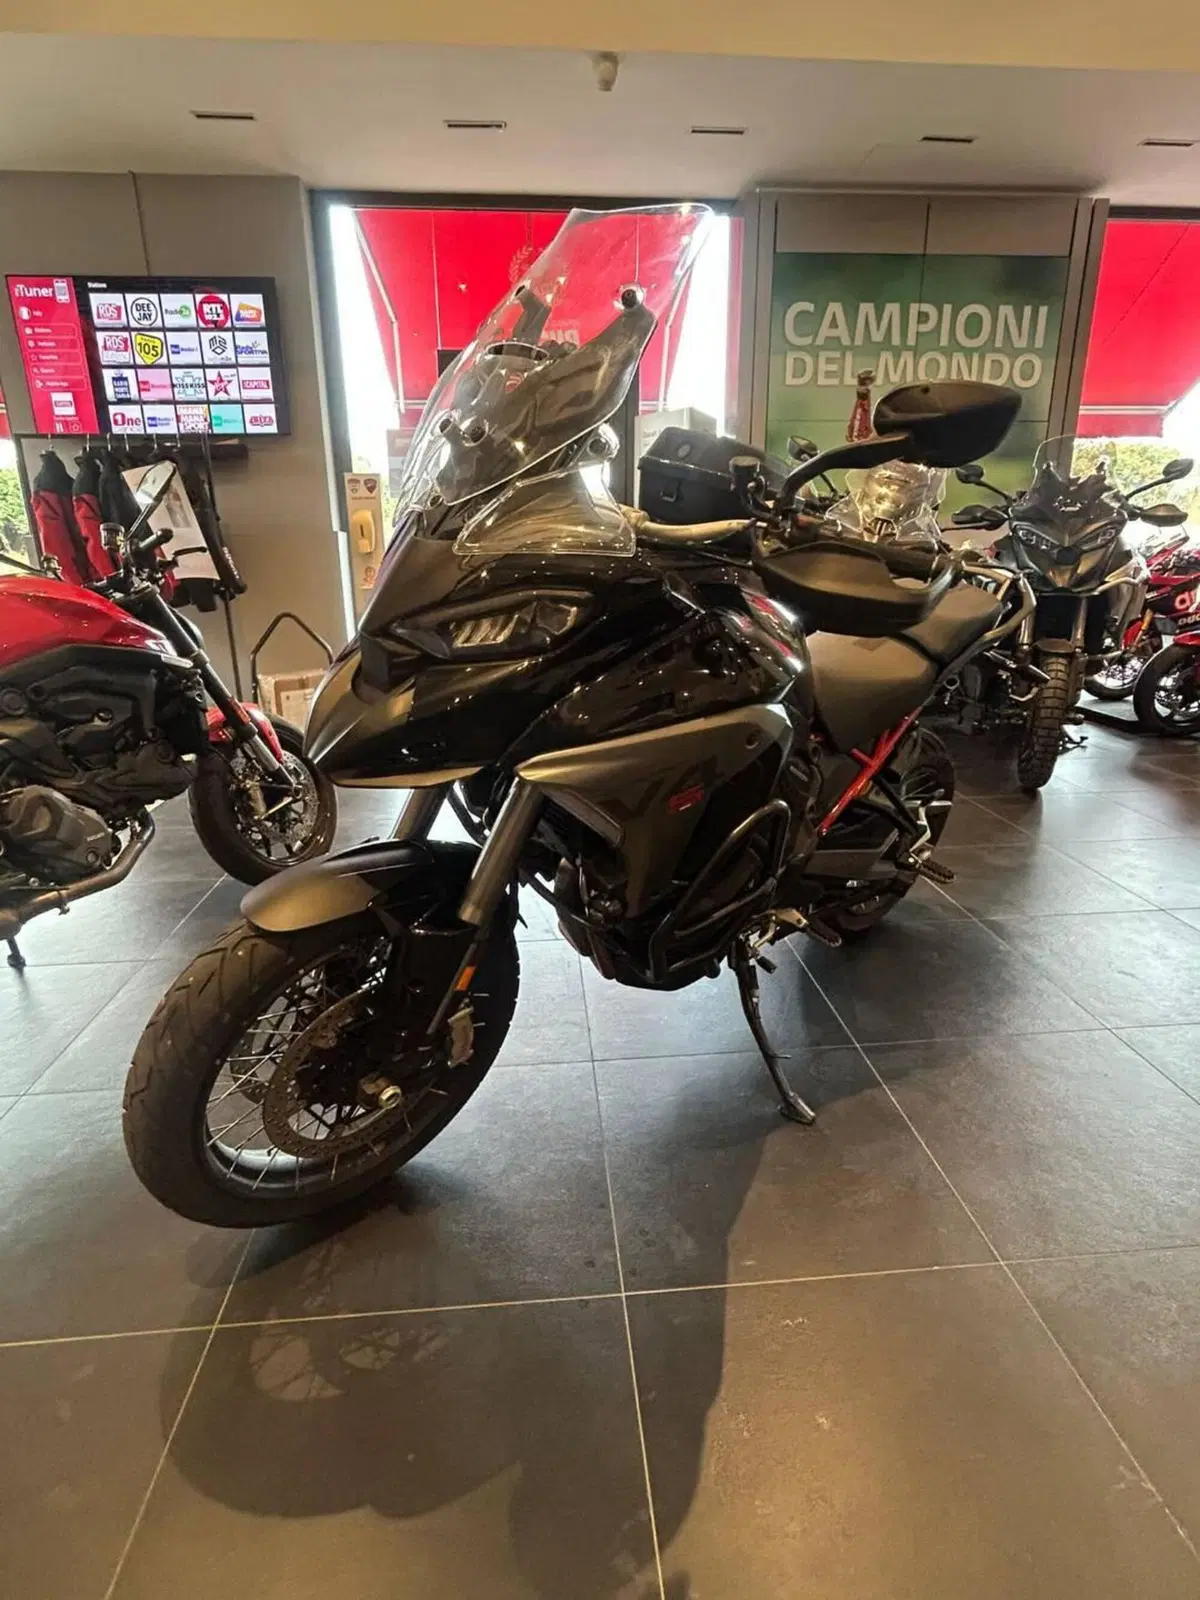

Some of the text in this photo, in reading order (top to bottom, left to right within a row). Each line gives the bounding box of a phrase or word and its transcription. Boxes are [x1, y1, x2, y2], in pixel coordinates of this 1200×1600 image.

[14, 284, 53, 297] iTuner
[135, 303, 153, 312] DEE
[137, 312, 153, 322] JAY
[784, 301, 1048, 349] CAMPIONI
[137, 342, 160, 358] 105
[785, 351, 1042, 388] DEL MONDO
